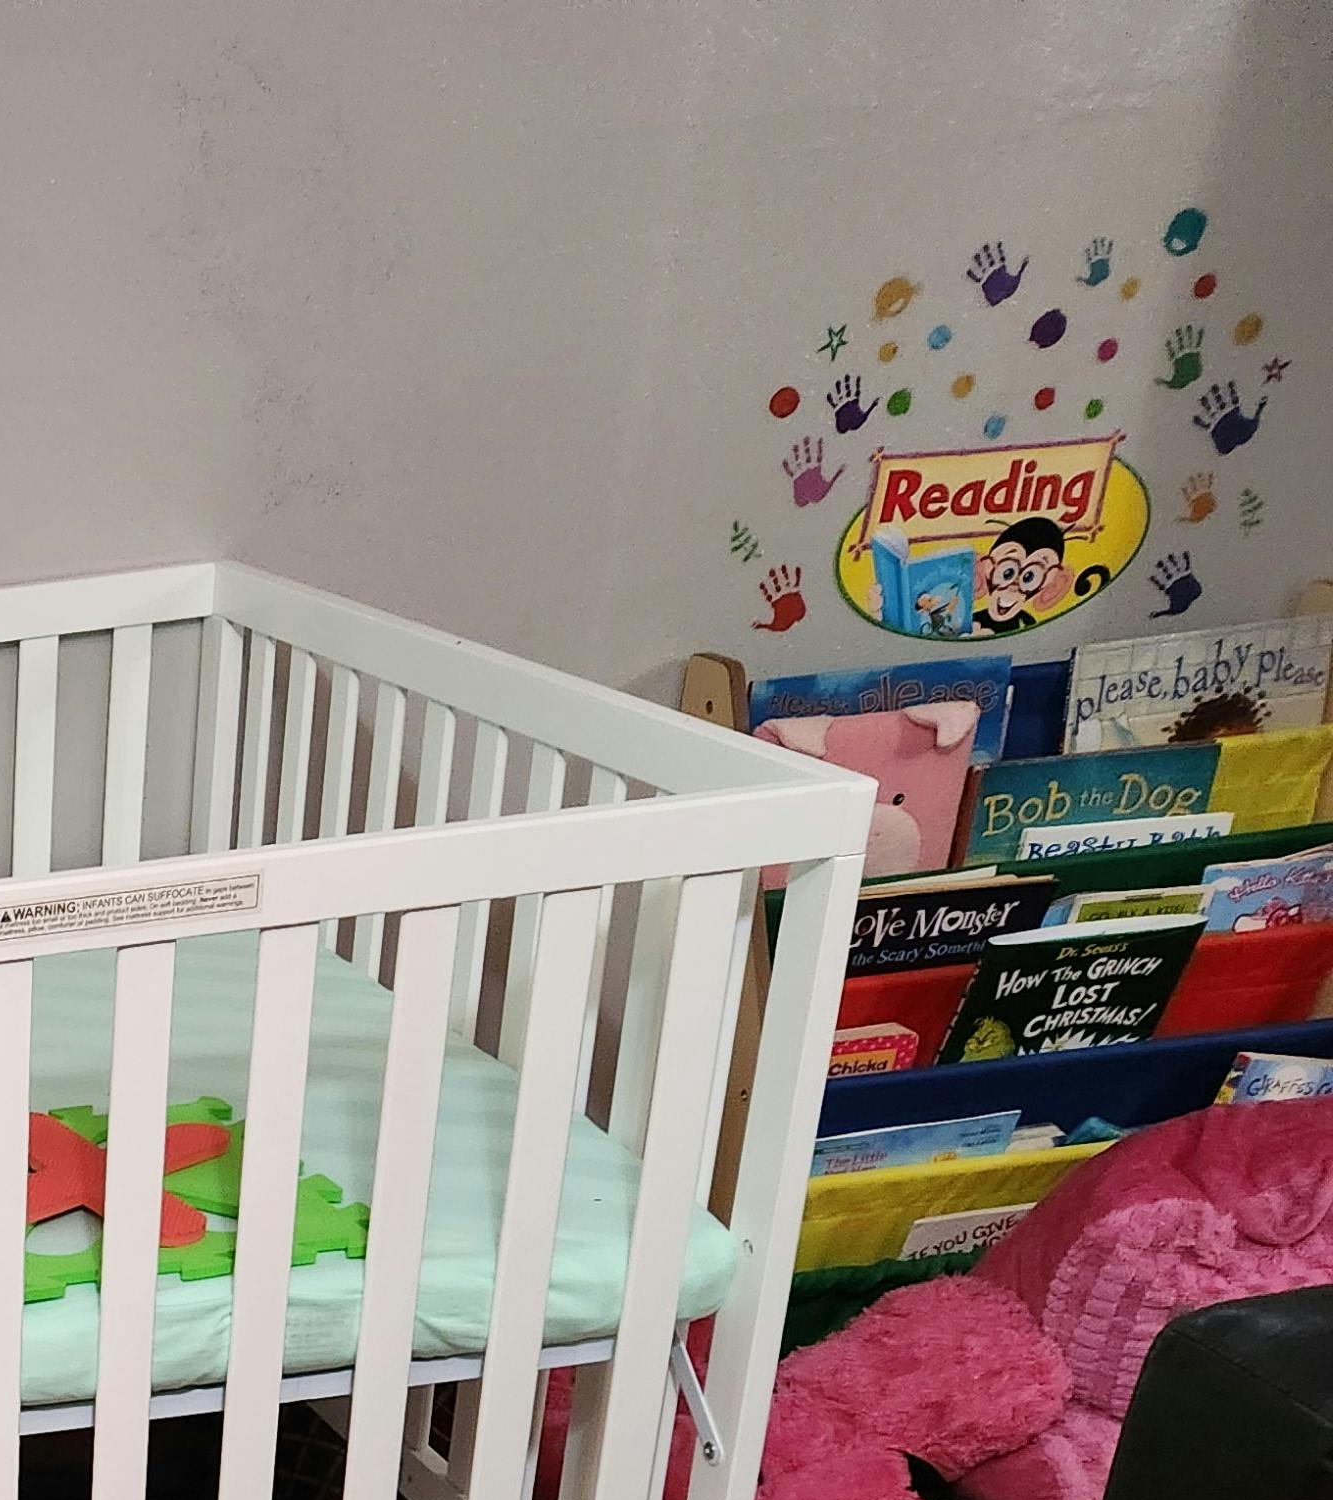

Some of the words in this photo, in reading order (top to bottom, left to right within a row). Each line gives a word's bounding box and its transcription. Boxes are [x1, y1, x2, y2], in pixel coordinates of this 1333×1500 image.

[880, 459, 1095, 524] Reading
[1071, 674, 1168, 736] please,
[1254, 647, 1325, 688] please
[982, 780, 1072, 837] Bob
[1079, 788, 1113, 809] the
[1111, 773, 1202, 817] Dog
[13, 901, 81, 921] WARNING:
[82, 896, 124, 910] INFANTS
[125, 893, 146, 905] CAN
[148, 886, 205, 901] SUFFOCATE
[906, 900, 1020, 941] Monster
[851, 951, 874, 966] the
[877, 947, 923, 965] Scary
[1051, 965, 1082, 983] The
[1086, 956, 1164, 980] GRINCH
[1056, 947, 1078, 960] Dr.
[1051, 981, 1121, 1010] LOST
[1023, 1002, 1158, 1038] CHRISTMAS!
[829, 1058, 889, 1077] Chicka
[1246, 1073, 1314, 1097] GIRAFFES
[932, 1230, 967, 1255] YOU
[973, 1213, 1018, 1240] GIVE
